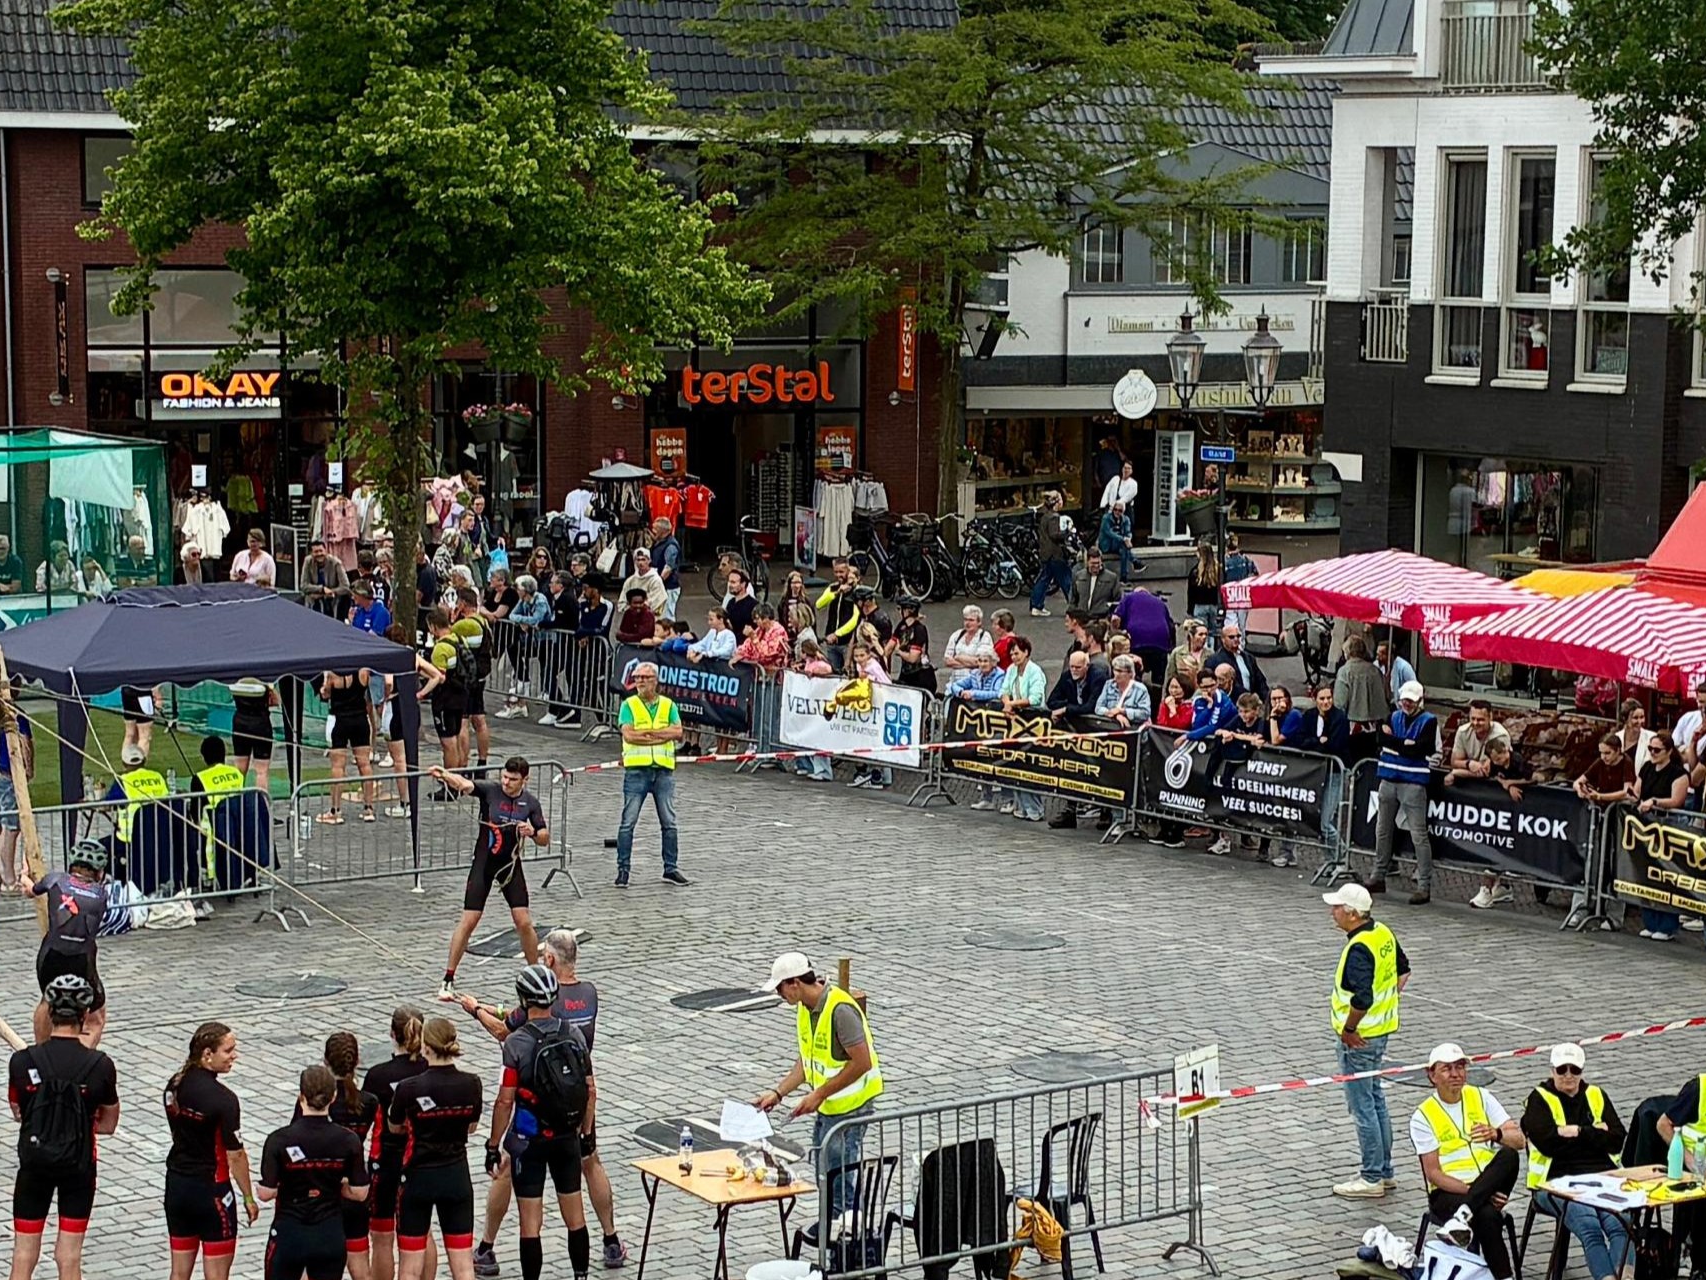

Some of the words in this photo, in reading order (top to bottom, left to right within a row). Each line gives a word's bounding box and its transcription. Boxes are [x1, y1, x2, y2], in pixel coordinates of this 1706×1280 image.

[160, 372, 281, 397] OKAY
[681, 360, 836, 405] terStal
[162, 397, 221, 409] FASHION
[224, 398, 235, 409] &
[236, 397, 281, 408] JEANS
[1428, 631, 1462, 651] SMALE
[656, 663, 740, 696] ONESTROO
[1627, 657, 1661, 681] SMALE
[976, 745, 1101, 778] SPORTSWEAR
[1246, 759, 1287, 778] WENST
[131, 776, 161, 788] CREW
[210, 772, 240, 785] CREW
[1237, 776, 1317, 804] DEELNEMERS
[1159, 790, 1206, 810] RUNNING
[1221, 795, 1247, 812] VEEL
[1248, 801, 1303, 821] SUCCES!
[1427, 800, 1512, 831] MUDDE
[1517, 813, 1569, 841] KOK
[1427, 823, 1515, 849] AUTOMOTIVE
